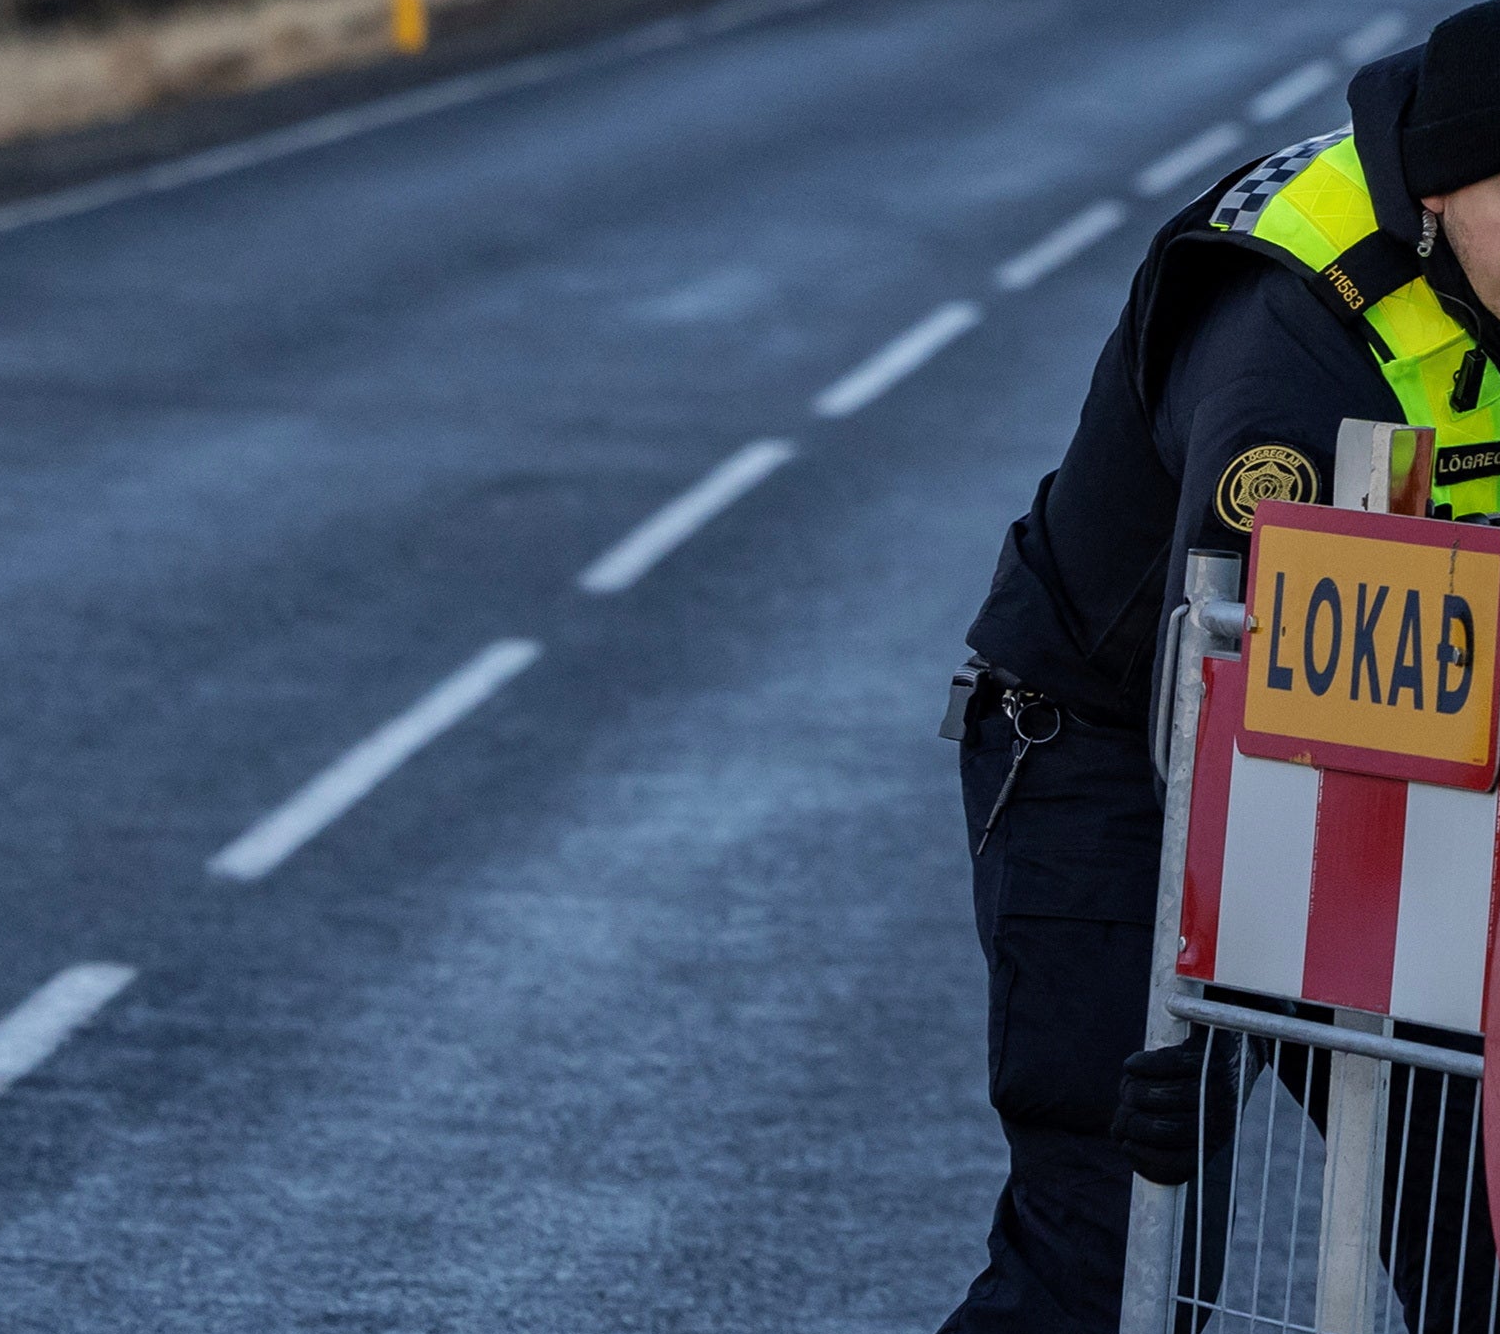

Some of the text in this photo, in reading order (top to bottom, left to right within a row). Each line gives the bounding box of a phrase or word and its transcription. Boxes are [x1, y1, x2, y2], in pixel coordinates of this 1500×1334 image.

[1325, 264, 1364, 310] H1583
[1242, 449, 1302, 468] LÖGREGLAN
[1267, 572, 1474, 715] LOKAÐ
